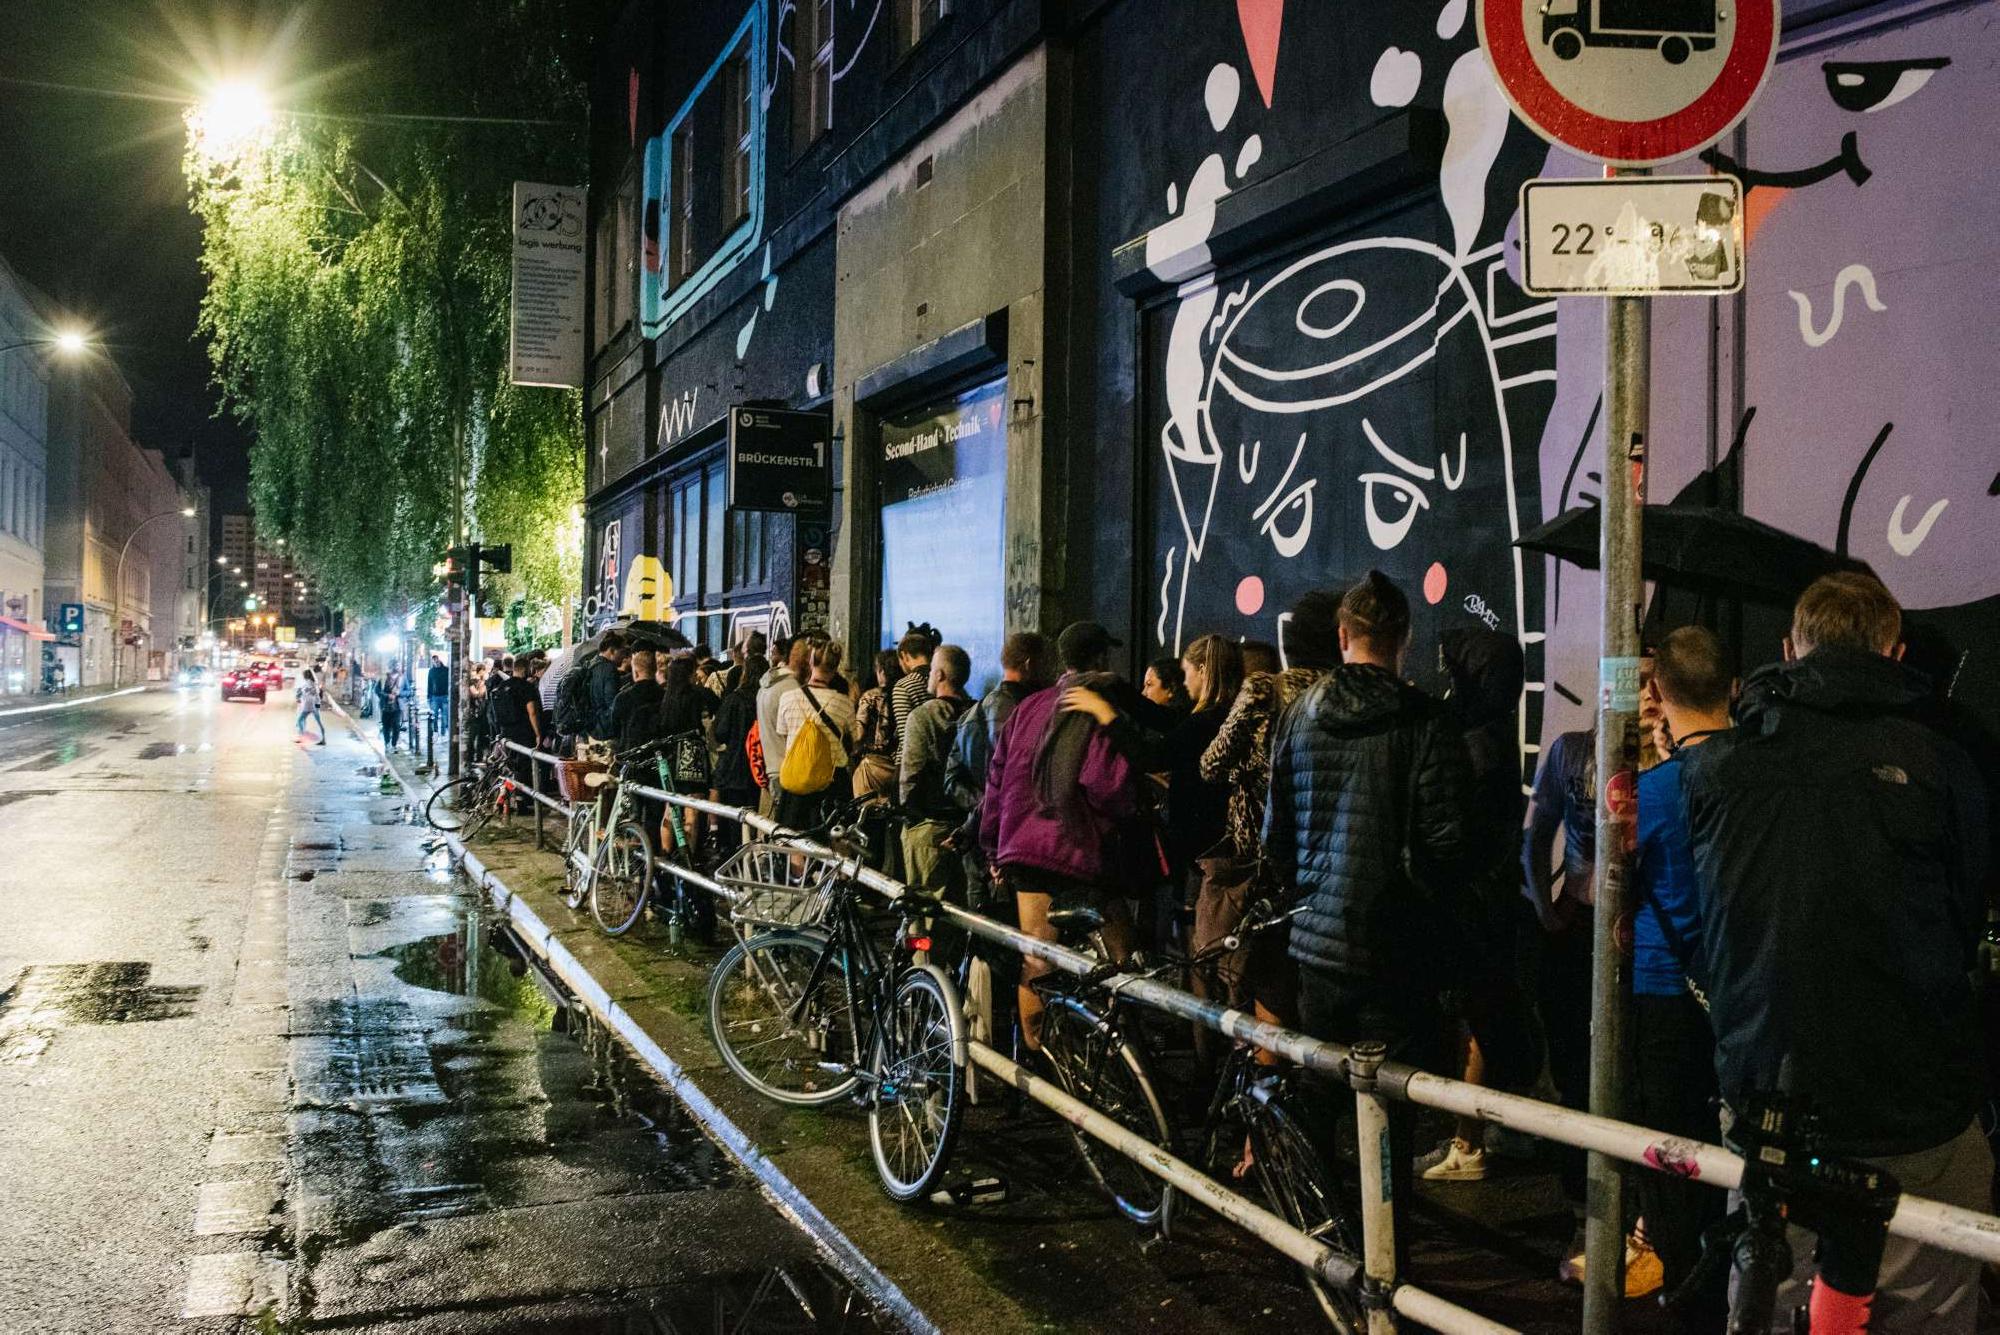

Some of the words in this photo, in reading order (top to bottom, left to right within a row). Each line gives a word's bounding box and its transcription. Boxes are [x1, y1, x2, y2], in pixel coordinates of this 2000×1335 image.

[542, 241, 582, 254] werbung
[1552, 222, 1595, 255] 22
[944, 415, 982, 444] Technik
[738, 451, 816, 467] BRÜCKENSTR.
[813, 441, 825, 468] 1
